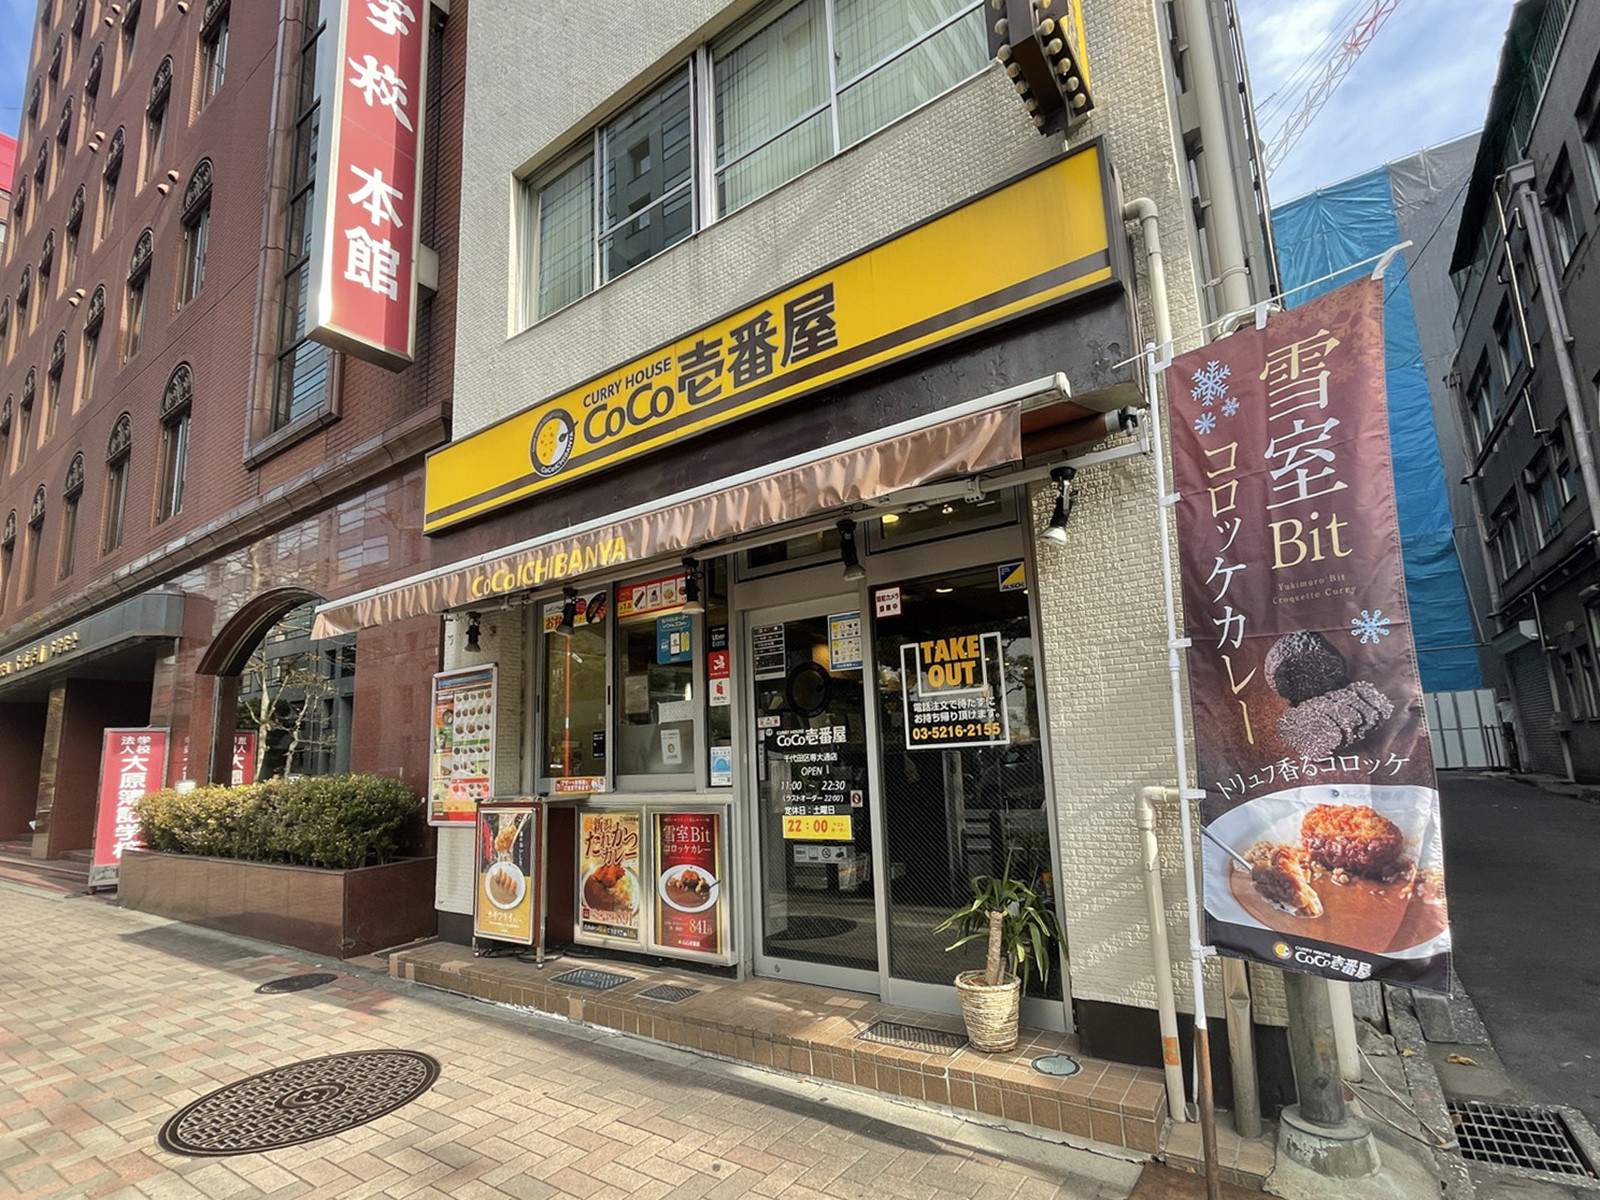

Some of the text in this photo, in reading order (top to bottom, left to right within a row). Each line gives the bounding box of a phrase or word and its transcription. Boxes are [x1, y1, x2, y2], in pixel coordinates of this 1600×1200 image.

[344, 164, 403, 302] 本館
[582, 357, 671, 408] CURRY HOUSE
[1259, 328, 1348, 510] 雪室
[1268, 511, 1353, 570] Bit
[1203, 441, 1257, 745] コロッケカレー
[1272, 586, 1357, 605] Croquette Curry
[1278, 573, 1345, 591] Yukimuro Bit
[711, 633, 726, 641] Uber
[920, 634, 980, 664] TAKE
[927, 660, 976, 688] OUT
[781, 780, 802, 790] 11:00
[821, 780, 846, 790] 22:30
[801, 766, 823, 776] OPEN
[1215, 752, 1411, 800] トリュフ香るコロッケ
